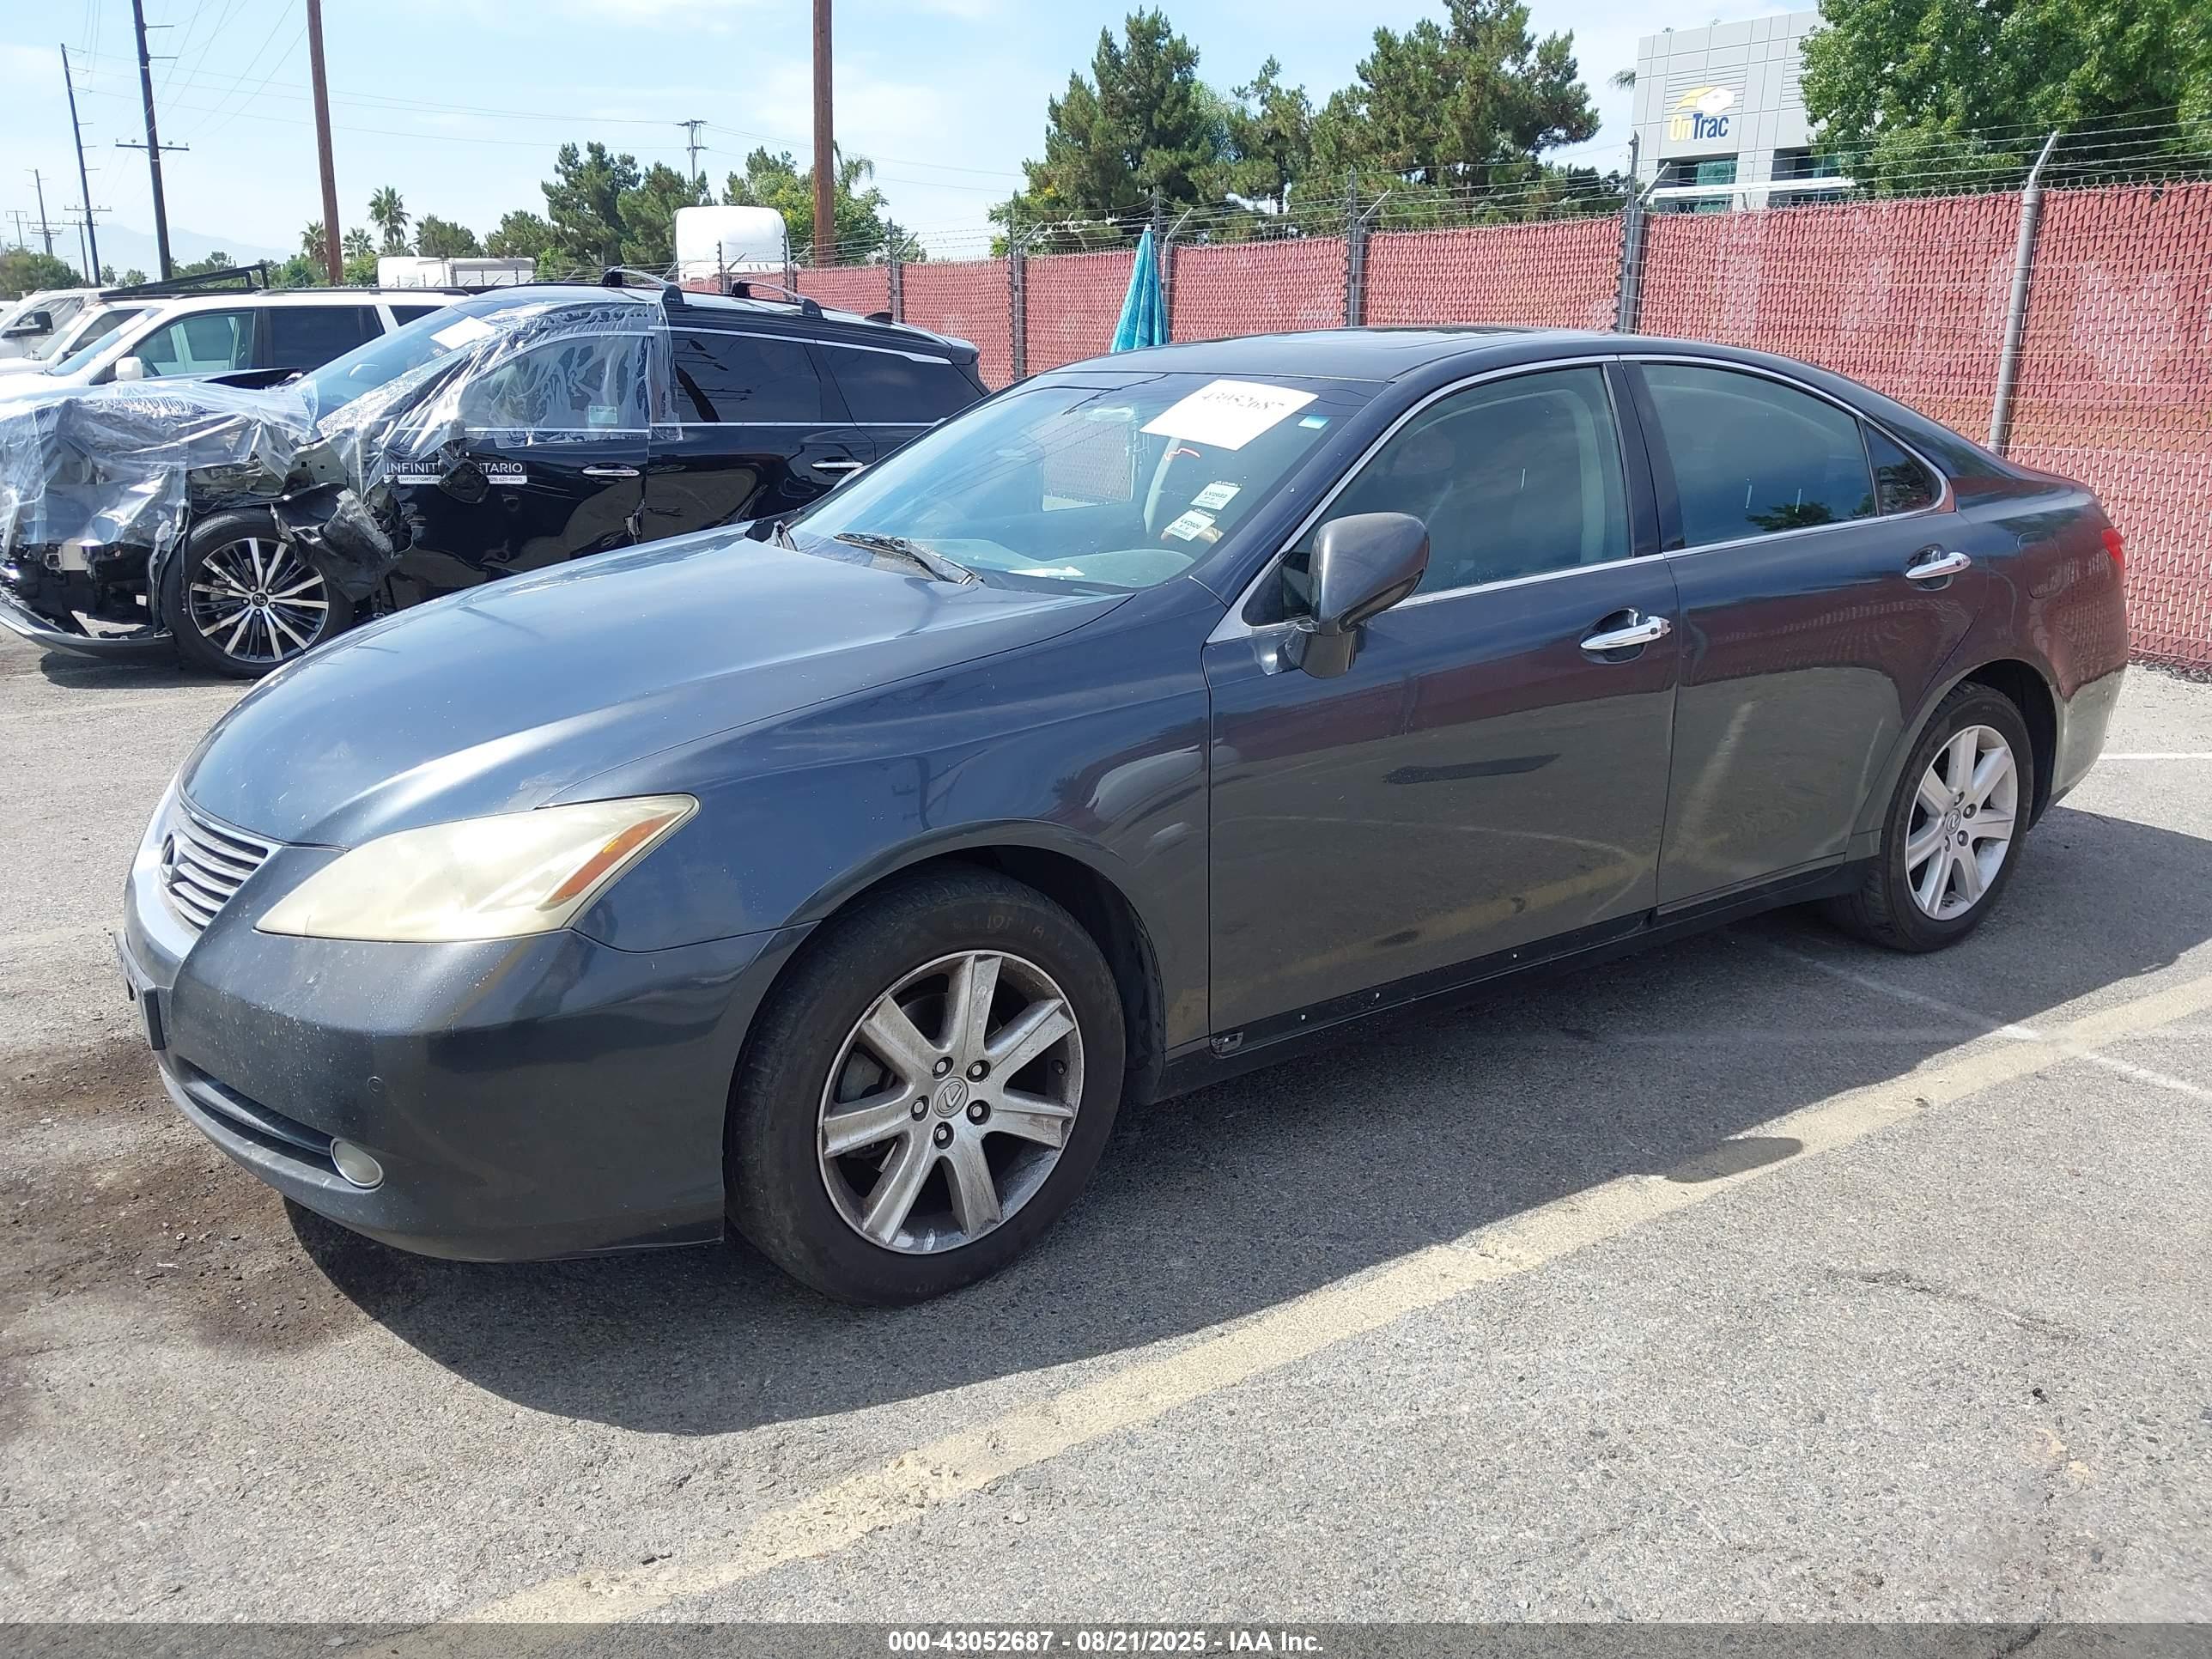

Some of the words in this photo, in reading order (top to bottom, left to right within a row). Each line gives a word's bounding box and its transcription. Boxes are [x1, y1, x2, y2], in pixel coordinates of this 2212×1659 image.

[1669, 112, 1729, 142] OnTrac
[386, 462, 438, 473] INFINIT
[479, 462, 523, 473] TARIO
